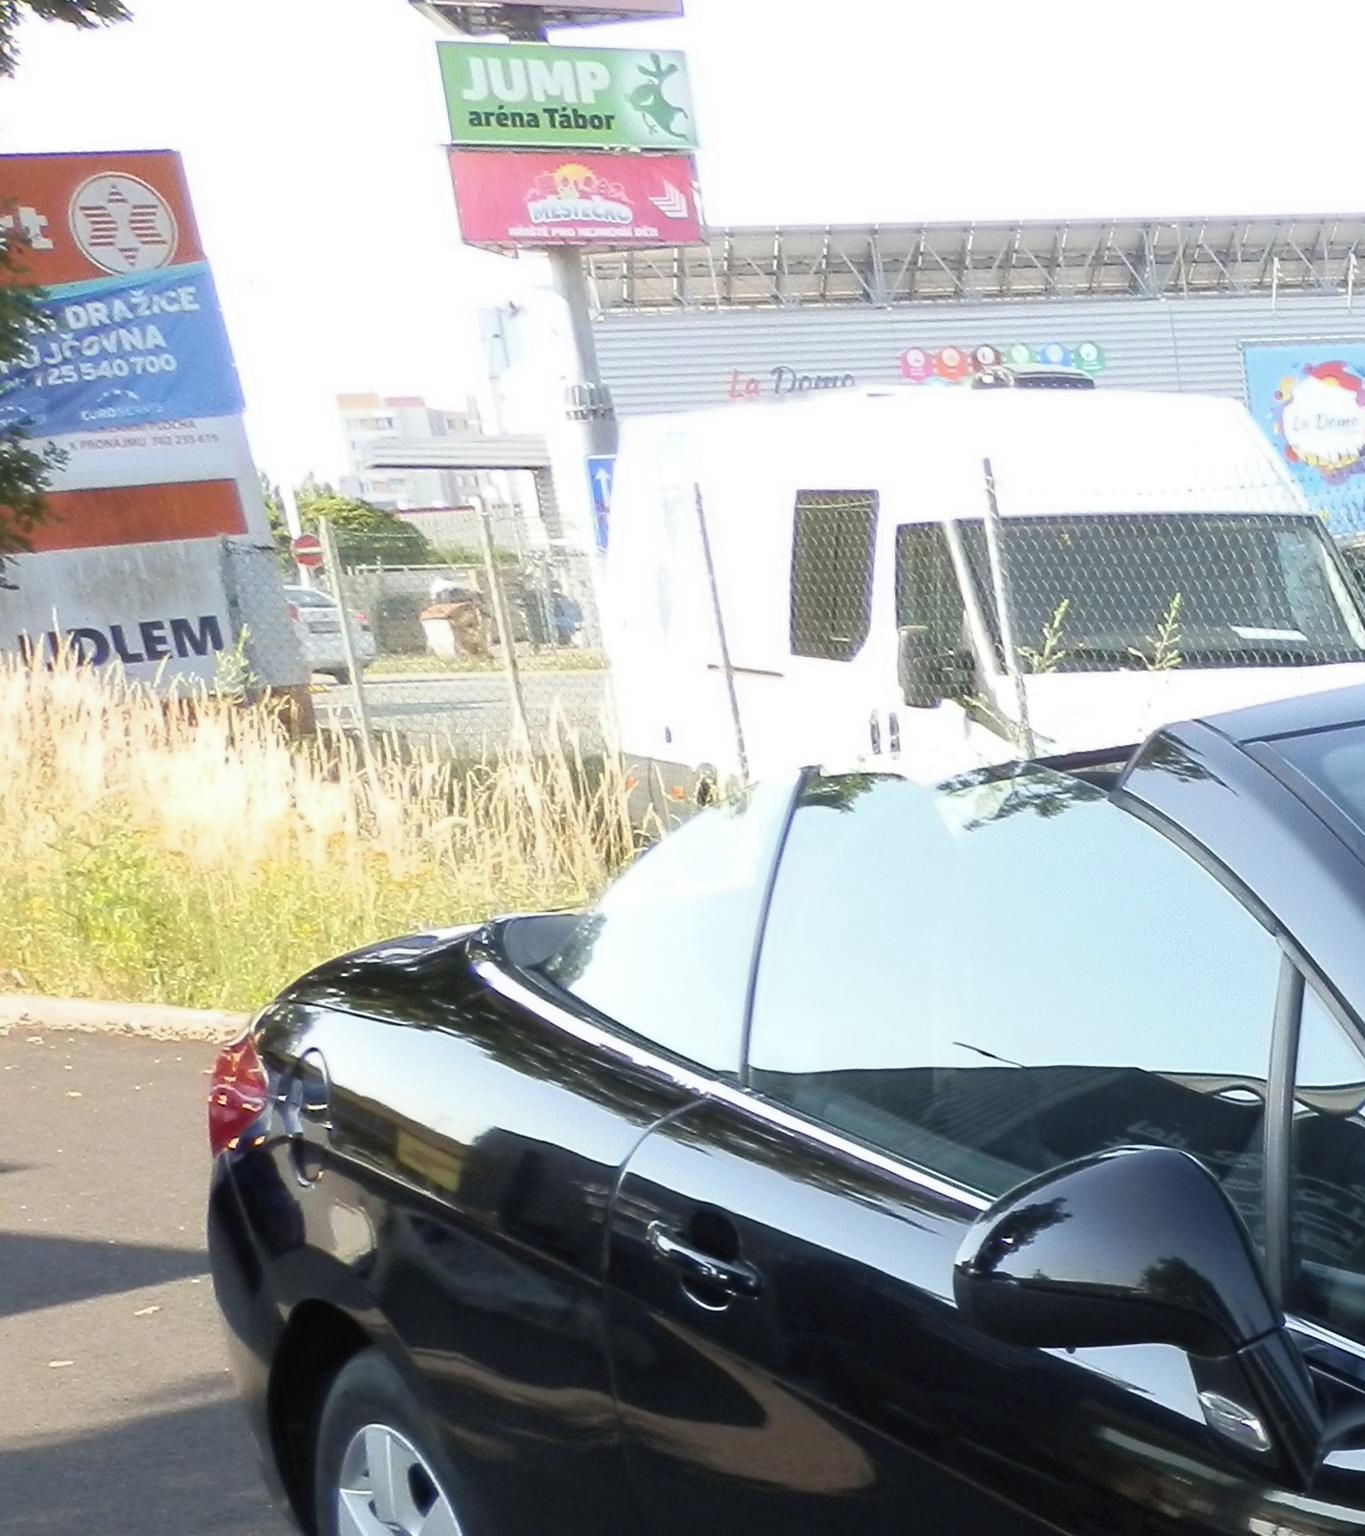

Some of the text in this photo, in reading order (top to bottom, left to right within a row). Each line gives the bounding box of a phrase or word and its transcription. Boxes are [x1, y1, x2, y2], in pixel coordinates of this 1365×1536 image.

[461, 55, 612, 104] JUMP
[468, 106, 616, 131] aréna Tábor
[64, 286, 200, 330] DRAŽICE
[79, 358, 130, 382] 540
[129, 353, 178, 375] 700
